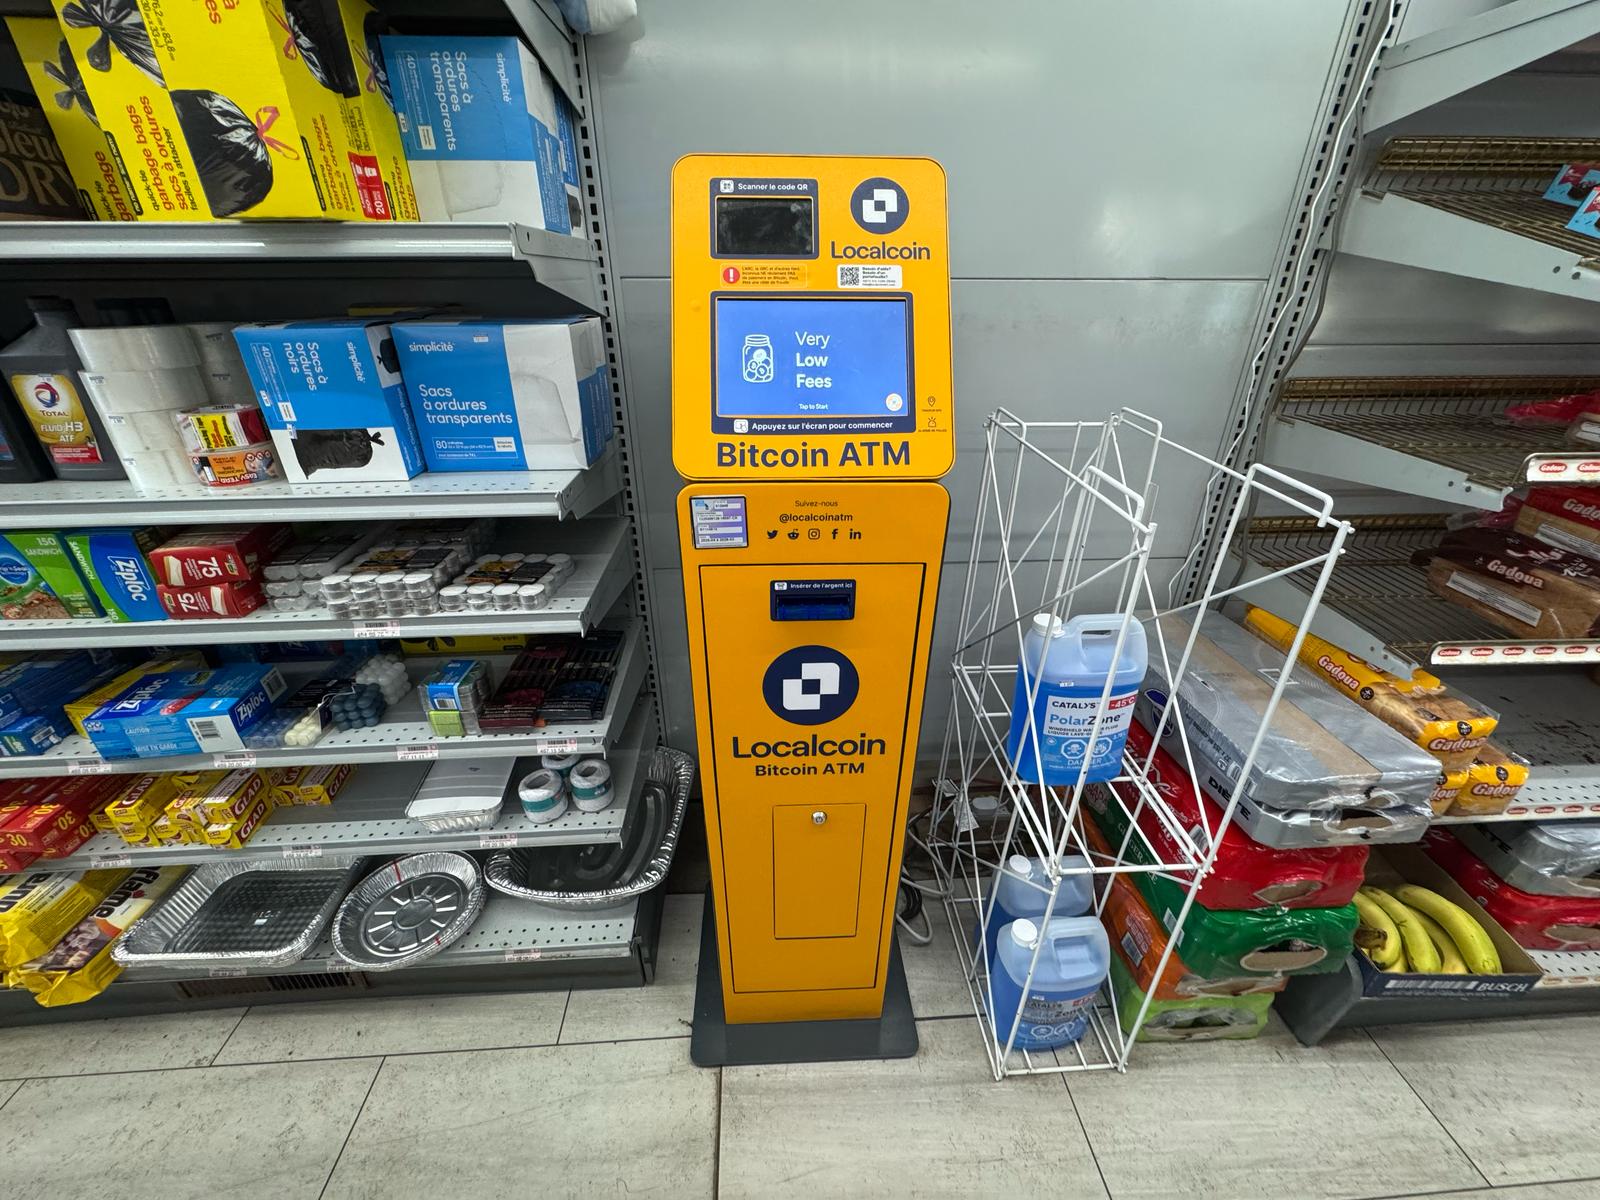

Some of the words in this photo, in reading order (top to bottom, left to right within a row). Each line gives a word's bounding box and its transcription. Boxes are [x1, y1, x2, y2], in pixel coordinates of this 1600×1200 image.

[442, 51, 461, 112] ordures
[454, 51, 470, 90] Sacs
[462, 94, 472, 104] à
[429, 51, 456, 151] transparents
[126, 105, 148, 145] bags
[140, 95, 169, 158] ordures
[163, 127, 183, 170] attacher
[142, 147, 175, 211] garbage
[161, 164, 175, 173] à
[94, 150, 134, 222] garbage
[138, 170, 160, 211] quick-tie
[168, 175, 189, 211] sacs
[182, 179, 199, 211] faciles
[738, 182, 768, 191] Scanner
[769, 183, 775, 191] le
[776, 183, 795, 191] code
[797, 183, 809, 192] QR
[374, 200, 386, 215] 20
[831, 241, 931, 260] Localcoin
[409, 342, 454, 354] simplicité
[795, 331, 830, 349] Very
[283, 342, 300, 374] noirs
[296, 342, 318, 391] ordures
[307, 342, 323, 373] Sacs
[318, 375, 328, 384] à
[796, 353, 828, 367] Low
[418, 384, 453, 397] Sacs
[796, 374, 832, 388] Fees
[423, 398, 432, 410] à
[435, 398, 487, 410] ordures
[799, 403, 809, 411] Tap
[427, 413, 513, 427] transparents
[752, 422, 786, 431] Appuyez
[801, 422, 828, 430] l'écran
[828, 423, 847, 431] pour
[848, 421, 893, 430] commencer
[60, 434, 75, 442] ATF
[435, 440, 447, 449] 80
[717, 441, 829, 467] Bitcoin
[839, 441, 910, 466] ATM
[795, 499, 838, 508] Suivez-nous
[779, 512, 853, 523] @localcoinatm
[36, 538, 56, 546] 150
[69, 540, 95, 580] SANDWICH
[198, 556, 223, 579] 75
[115, 558, 148, 602] Ziploc
[821, 582, 844, 590] l'argent
[1487, 559, 1544, 588] Gadoua
[107, 608, 119, 622] 150
[179, 592, 195, 613] 75
[1318, 655, 1360, 690] Gadoua
[115, 678, 169, 711] Ziploc
[237, 691, 265, 721] Ziploc
[125, 727, 149, 735] CAUTION
[732, 733, 886, 758] Localcoin
[329, 764, 351, 797] GLAD
[755, 763, 817, 776] Bitcoin
[822, 762, 865, 774] ATM
[122, 777, 154, 806] GLAD
[234, 778, 263, 815] GLAD
[1207, 774, 1251, 822] DIÈE
[241, 803, 265, 839] GLAD
[6, 833, 27, 847] 30
[1477, 982, 1529, 993] BUSCH
